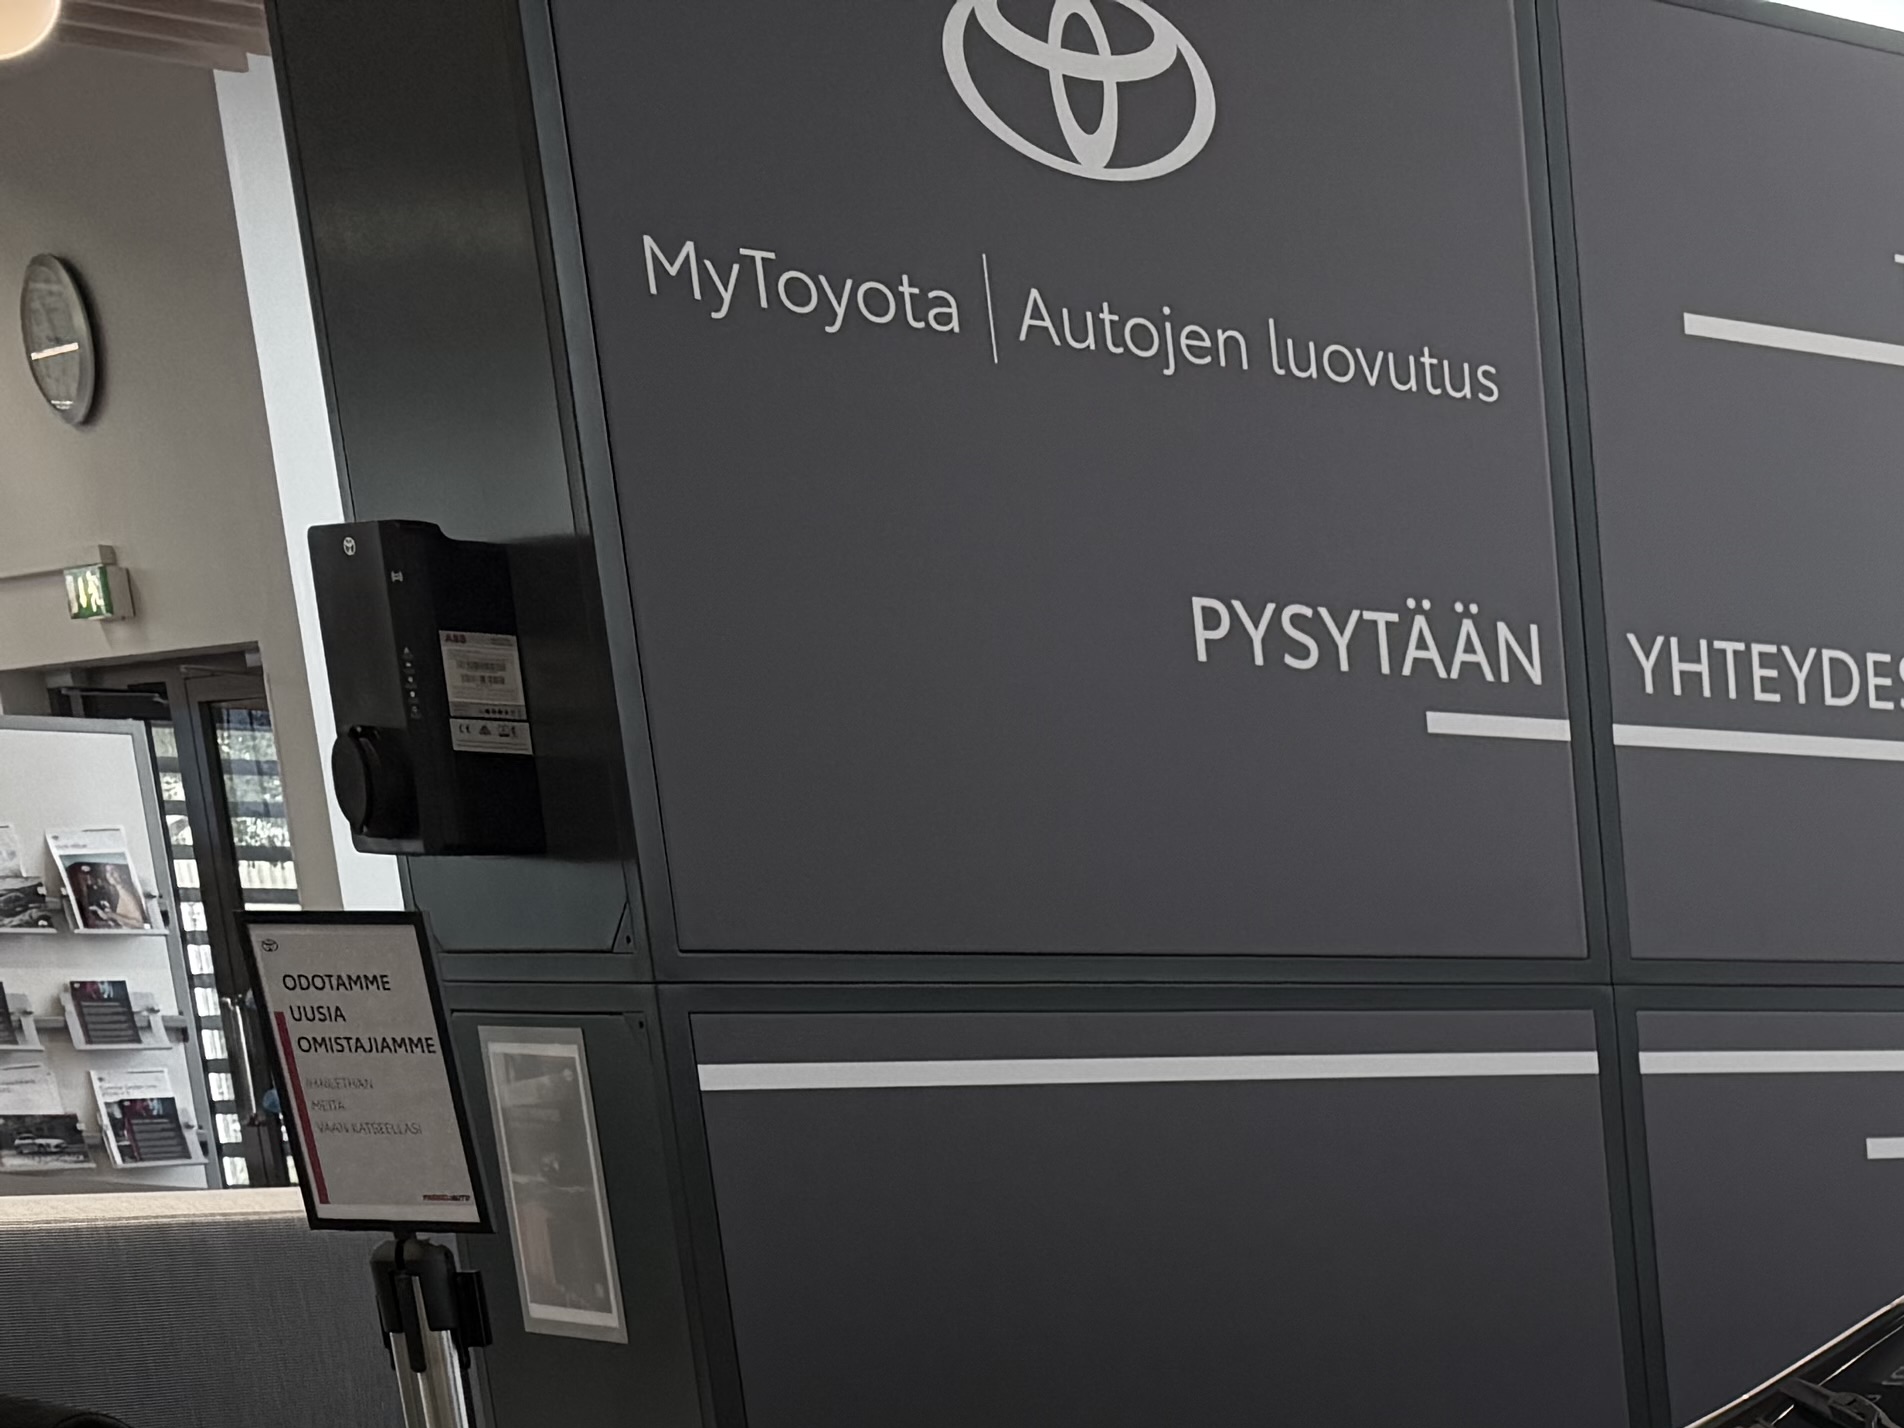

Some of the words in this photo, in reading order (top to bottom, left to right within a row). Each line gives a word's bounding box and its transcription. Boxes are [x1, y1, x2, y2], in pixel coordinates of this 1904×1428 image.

[643, 234, 961, 333] MyToyota
[1019, 288, 1249, 376] Autojen
[1268, 318, 1500, 403] luovutus
[1191, 596, 1542, 685] PYSYTÄÄN
[282, 974, 392, 992] ODOTAMME
[290, 1005, 347, 1022] UUSIA
[297, 1036, 438, 1054] OMISTAJIAMME
